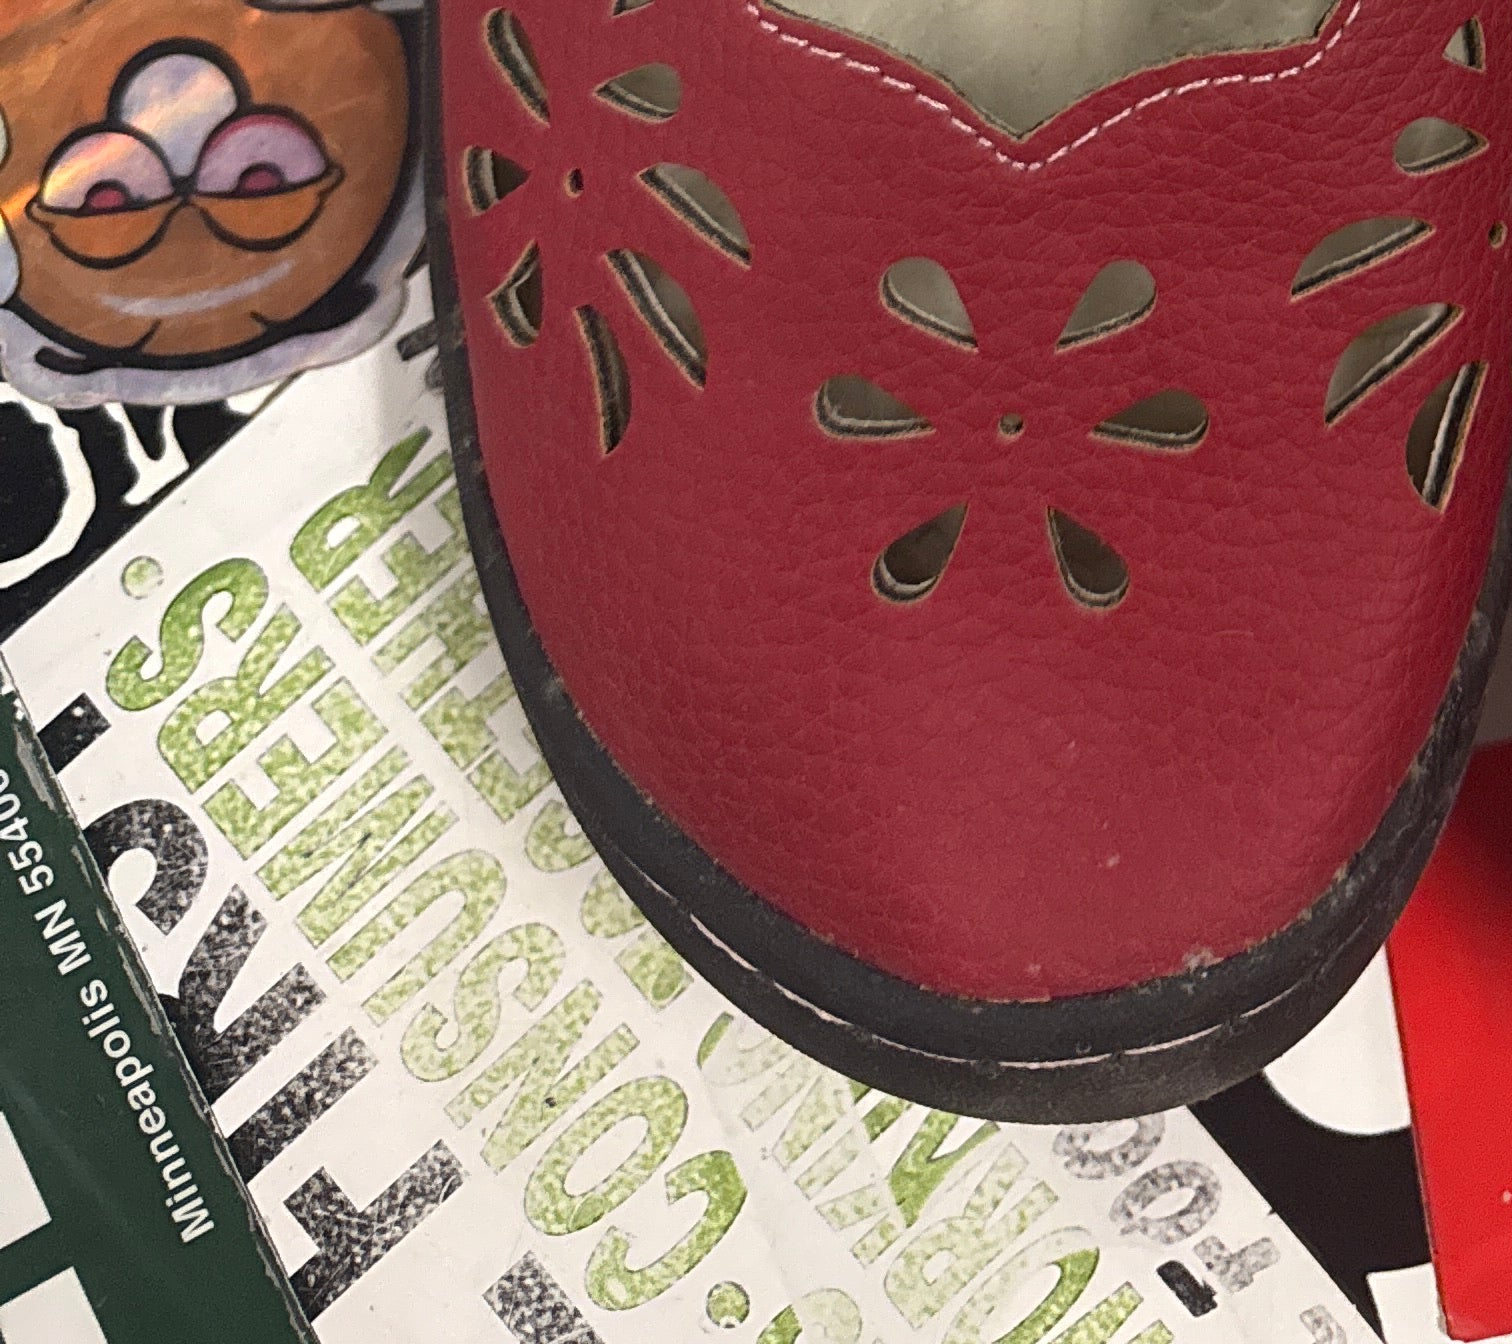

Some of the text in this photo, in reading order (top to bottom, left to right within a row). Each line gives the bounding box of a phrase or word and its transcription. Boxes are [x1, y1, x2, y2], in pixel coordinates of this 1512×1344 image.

[0, 764, 215, 1244] Minneapolis MN 5540
[105, 556, 749, 1312] CONSUMERS
